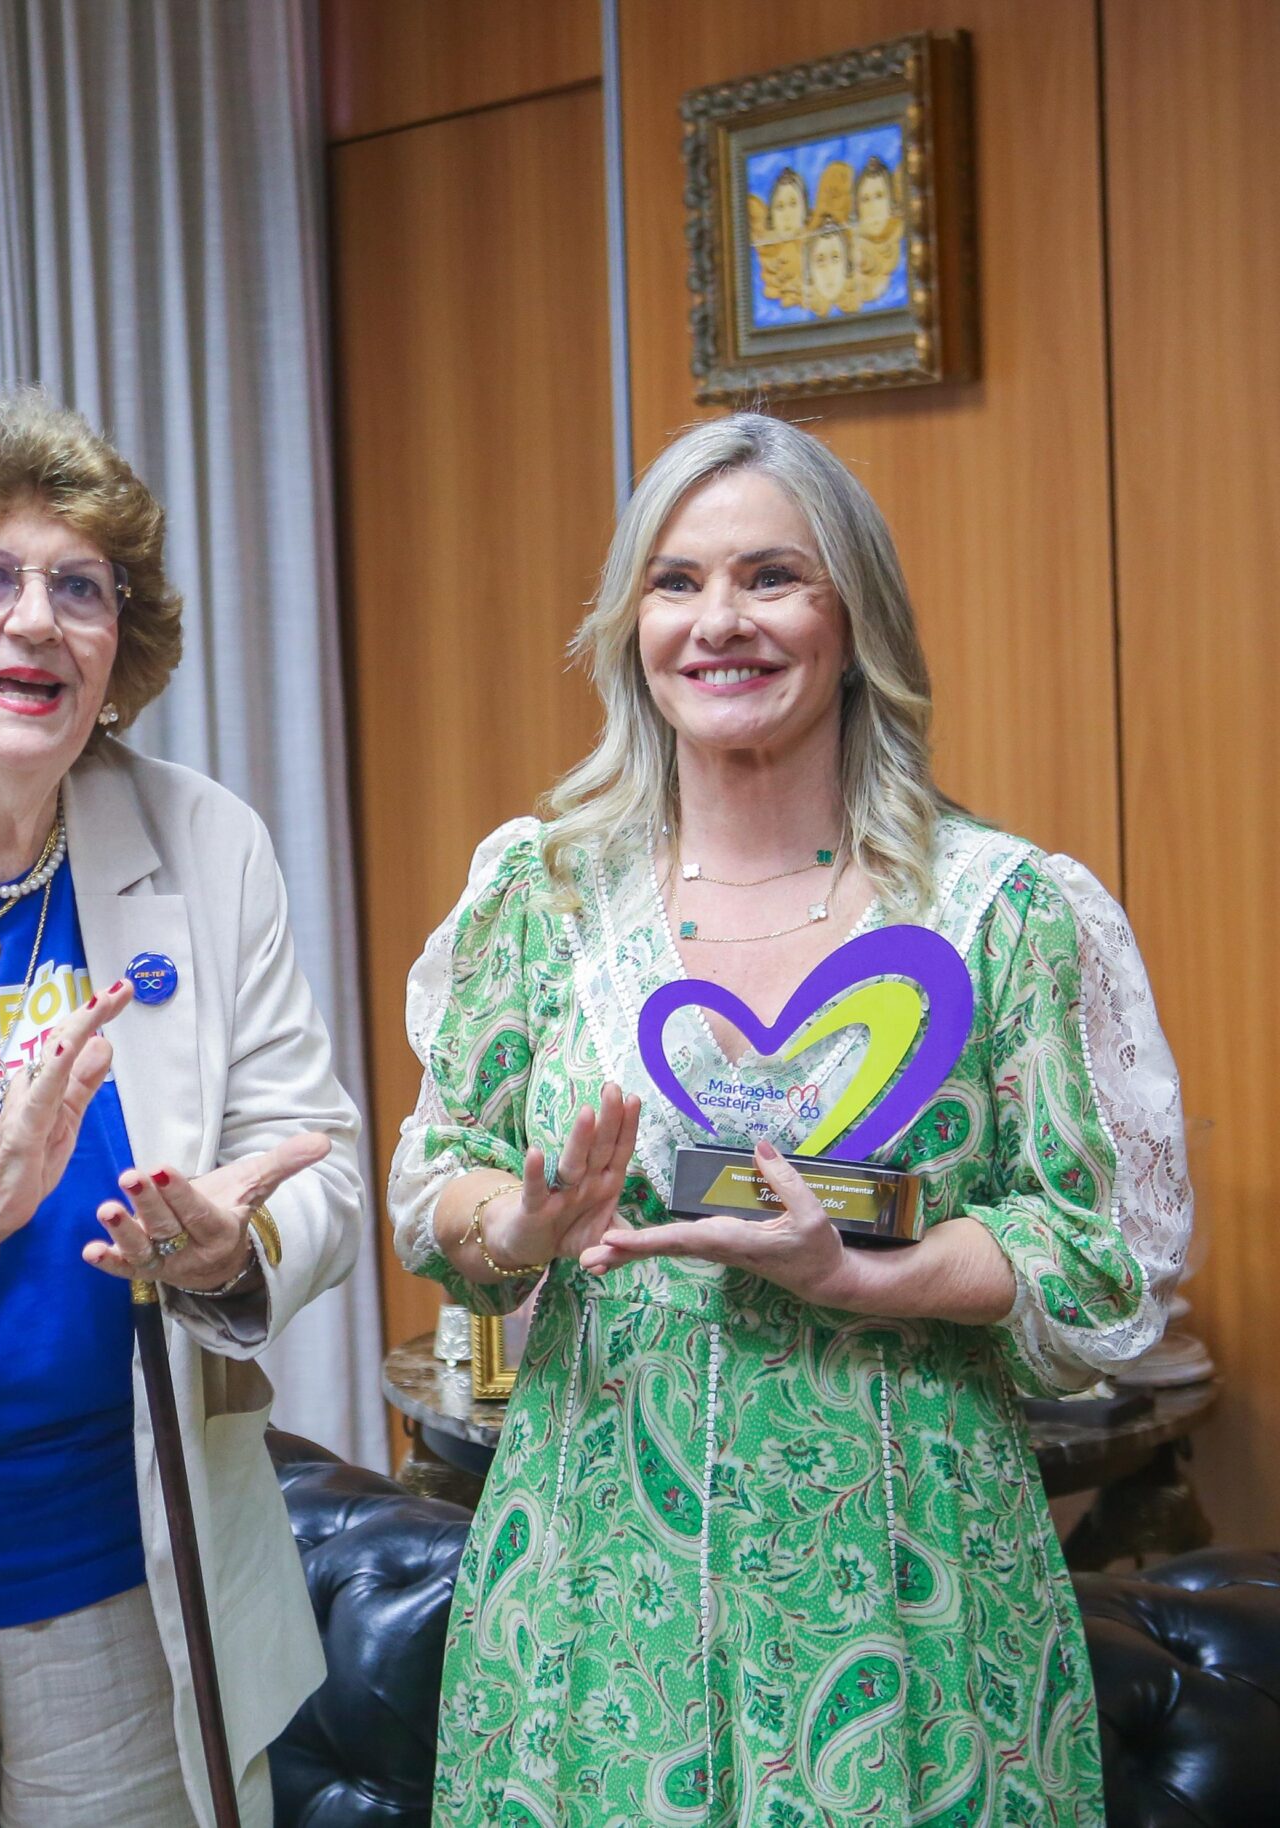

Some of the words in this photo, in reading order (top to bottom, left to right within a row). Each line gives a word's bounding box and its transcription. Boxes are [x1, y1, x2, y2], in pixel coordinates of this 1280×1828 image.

[708, 1079, 785, 1101] Martagão
[696, 1091, 761, 1113] Gesteira
[756, 1188, 782, 1203] Iva
[830, 1184, 875, 1195] parlamentar
